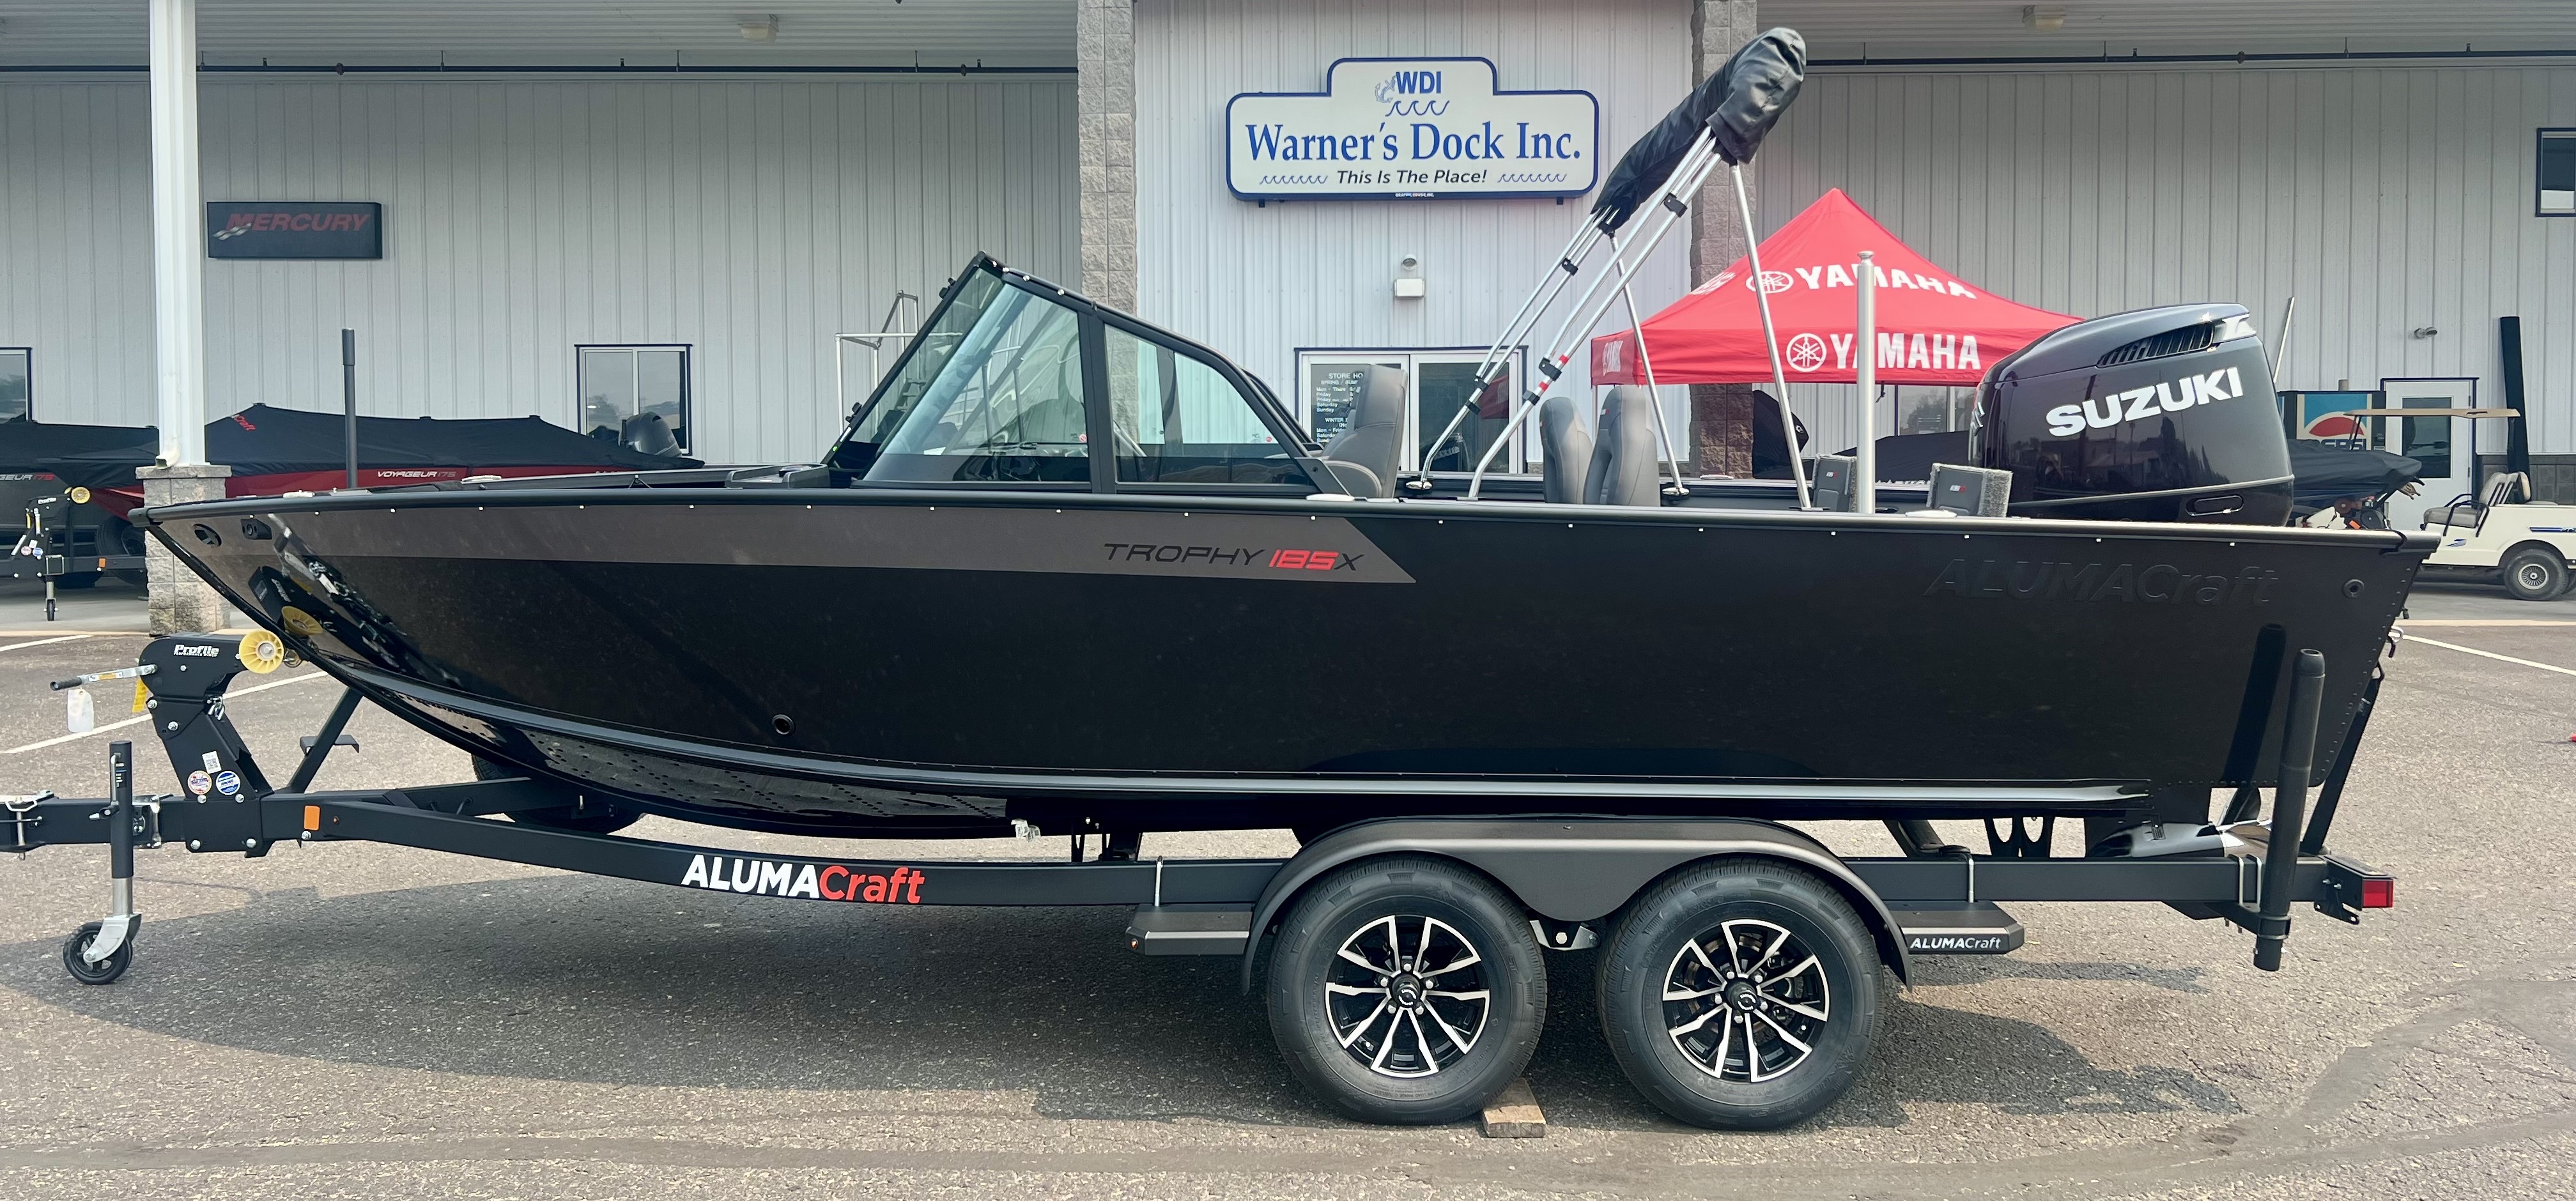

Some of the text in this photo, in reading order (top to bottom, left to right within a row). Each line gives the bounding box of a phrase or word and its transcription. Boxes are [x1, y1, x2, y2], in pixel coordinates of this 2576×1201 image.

[1395, 72, 1441, 94] WDI
[1246, 121, 1580, 161] Warner's Dock Inc.
[1338, 169, 1487, 185] This Is The Place!
[226, 213, 371, 231] MERCURY
[2046, 366, 2244, 437] SUZUKI
[1104, 543, 1265, 566] TROPHY
[1922, 558, 2279, 606] ALUMACraft
[174, 644, 220, 655] Profile
[681, 854, 925, 904] ALUMACraft
[1910, 937, 2001, 949] ALUMACraft
